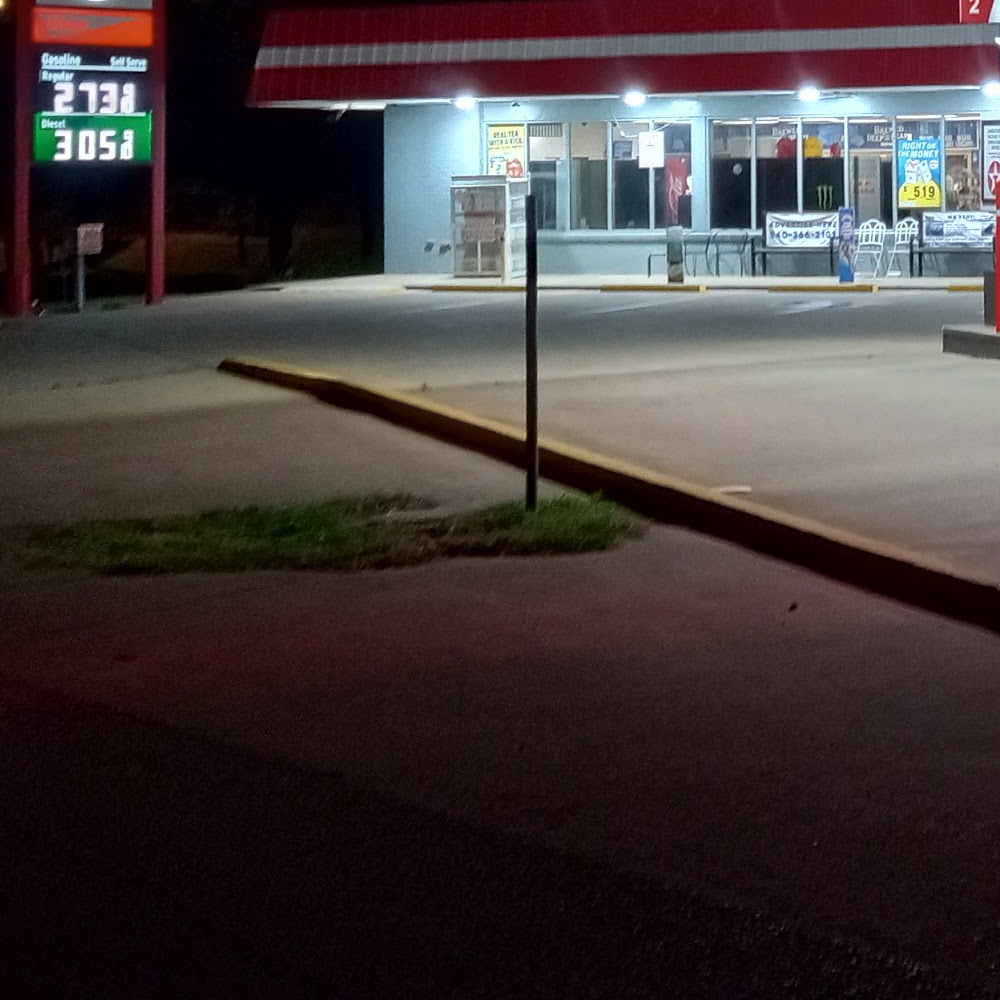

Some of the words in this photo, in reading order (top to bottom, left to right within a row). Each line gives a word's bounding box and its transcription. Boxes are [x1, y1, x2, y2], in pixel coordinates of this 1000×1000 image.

[41, 52, 82, 66] Gasoline
[110, 55, 125, 67] Self
[126, 56, 147, 68] Serve
[41, 70, 75, 83] Regular
[41, 118, 66, 129] Diesel
[508, 130, 519, 138] TEA
[901, 141, 927, 150] RIGHT
[926, 142, 937, 150] ON
[909, 149, 940, 159] MONEY
